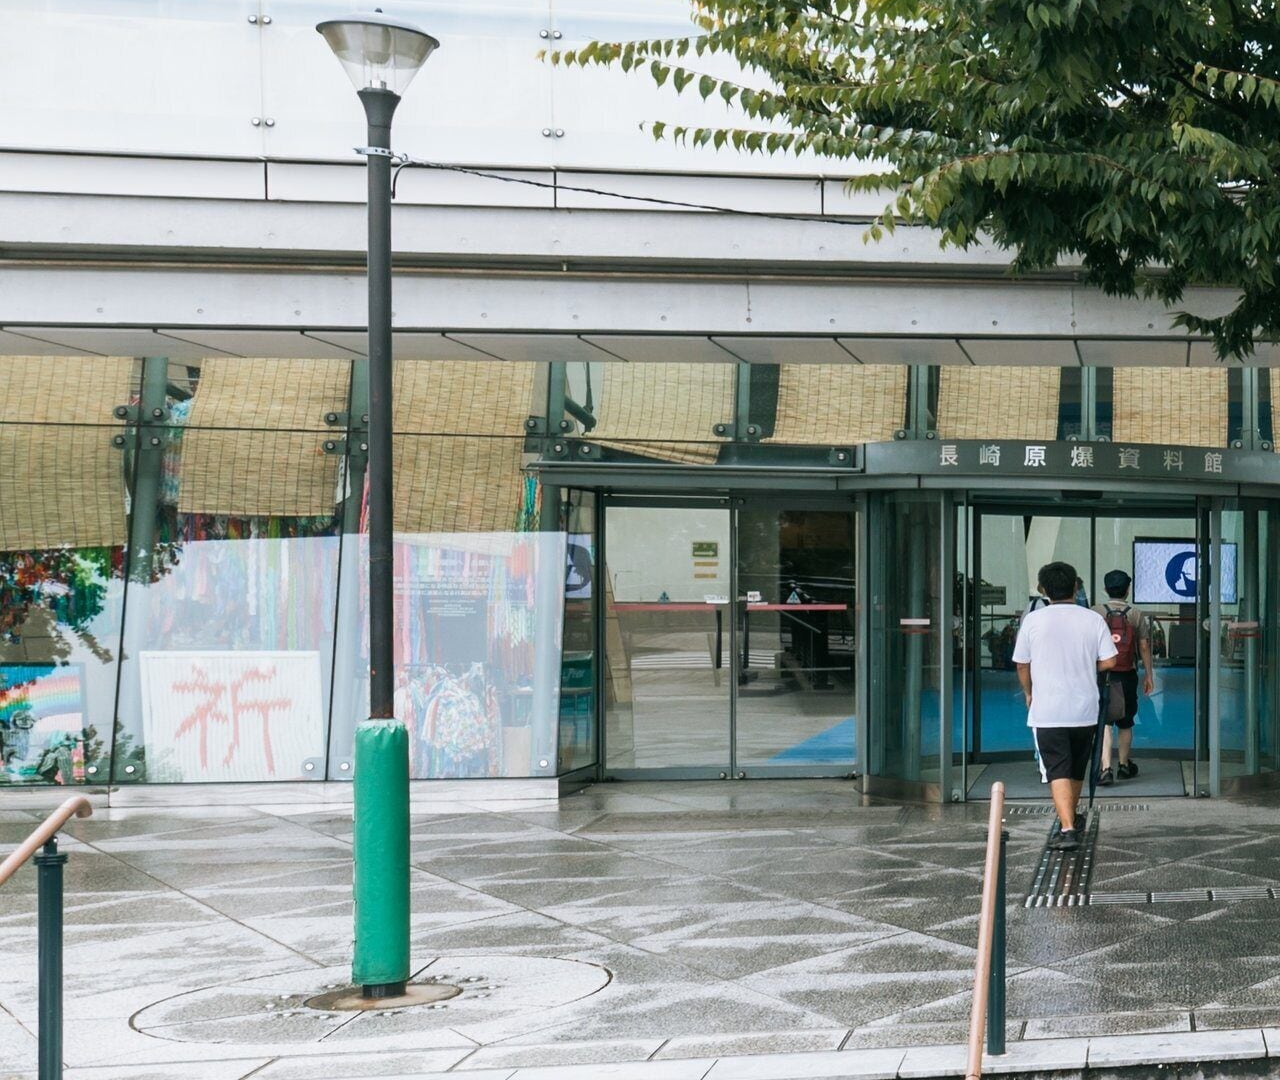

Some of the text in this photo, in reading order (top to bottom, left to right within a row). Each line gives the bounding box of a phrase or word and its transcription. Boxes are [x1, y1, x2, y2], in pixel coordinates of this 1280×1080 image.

[939, 444, 1224, 474] 長崎原爆資料館
[171, 663, 292, 775] 祈
